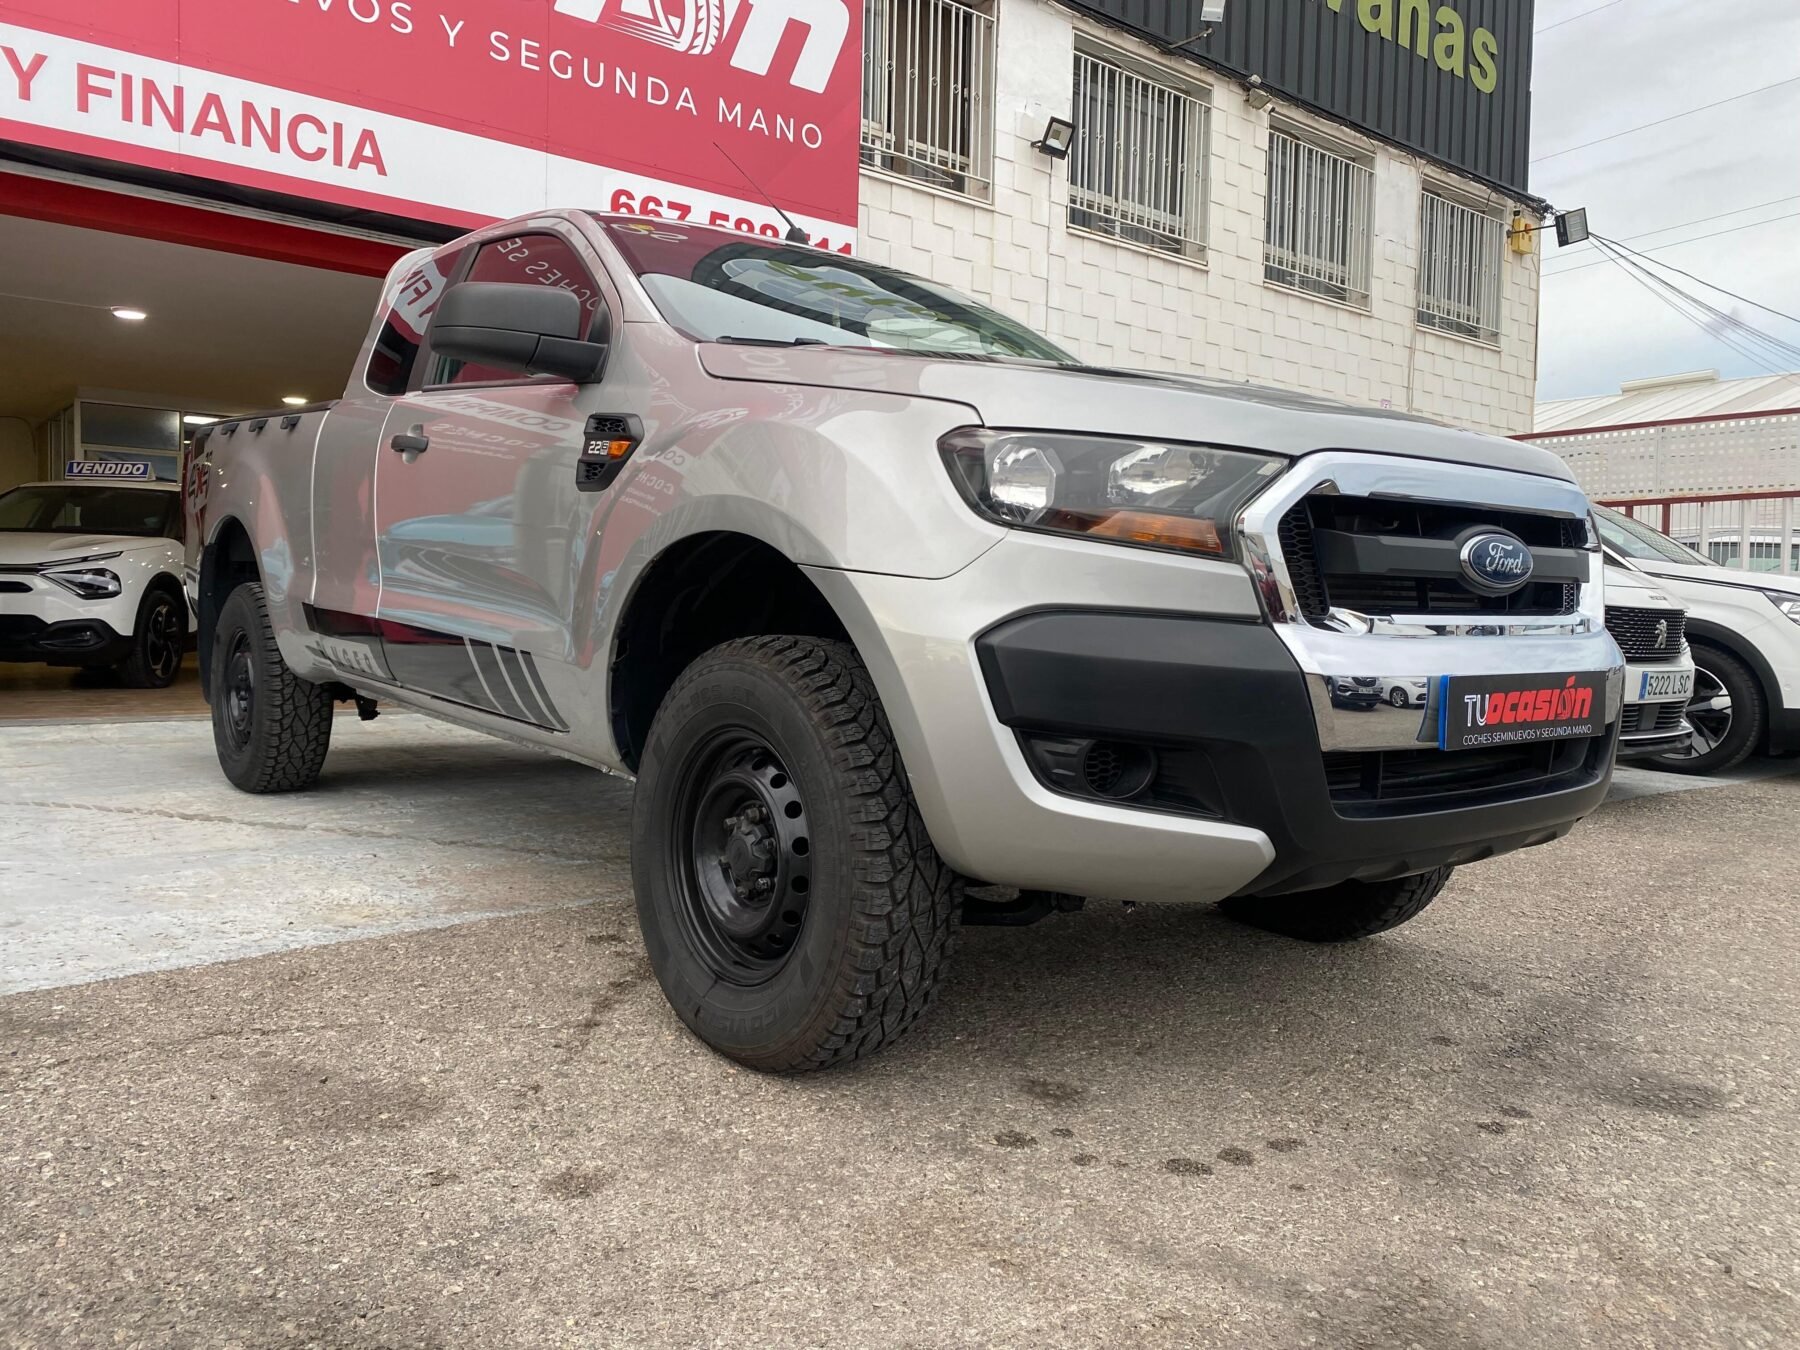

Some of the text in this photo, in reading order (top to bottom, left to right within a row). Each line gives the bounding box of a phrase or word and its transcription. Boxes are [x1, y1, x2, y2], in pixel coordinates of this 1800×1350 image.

[439, 14, 464, 47] Y
[489, 30, 698, 116] SEGUNDA
[718, 97, 823, 149] MANO
[0, 46, 388, 177] Y FINANCIA
[72, 462, 145, 475] VENDIDO
[1486, 542, 1524, 574] Ford
[1647, 674, 1691, 696] 5222 LSC
[1462, 723, 1592, 746] COCHES SEMINUEVOS Y SEGUNDA MANO
